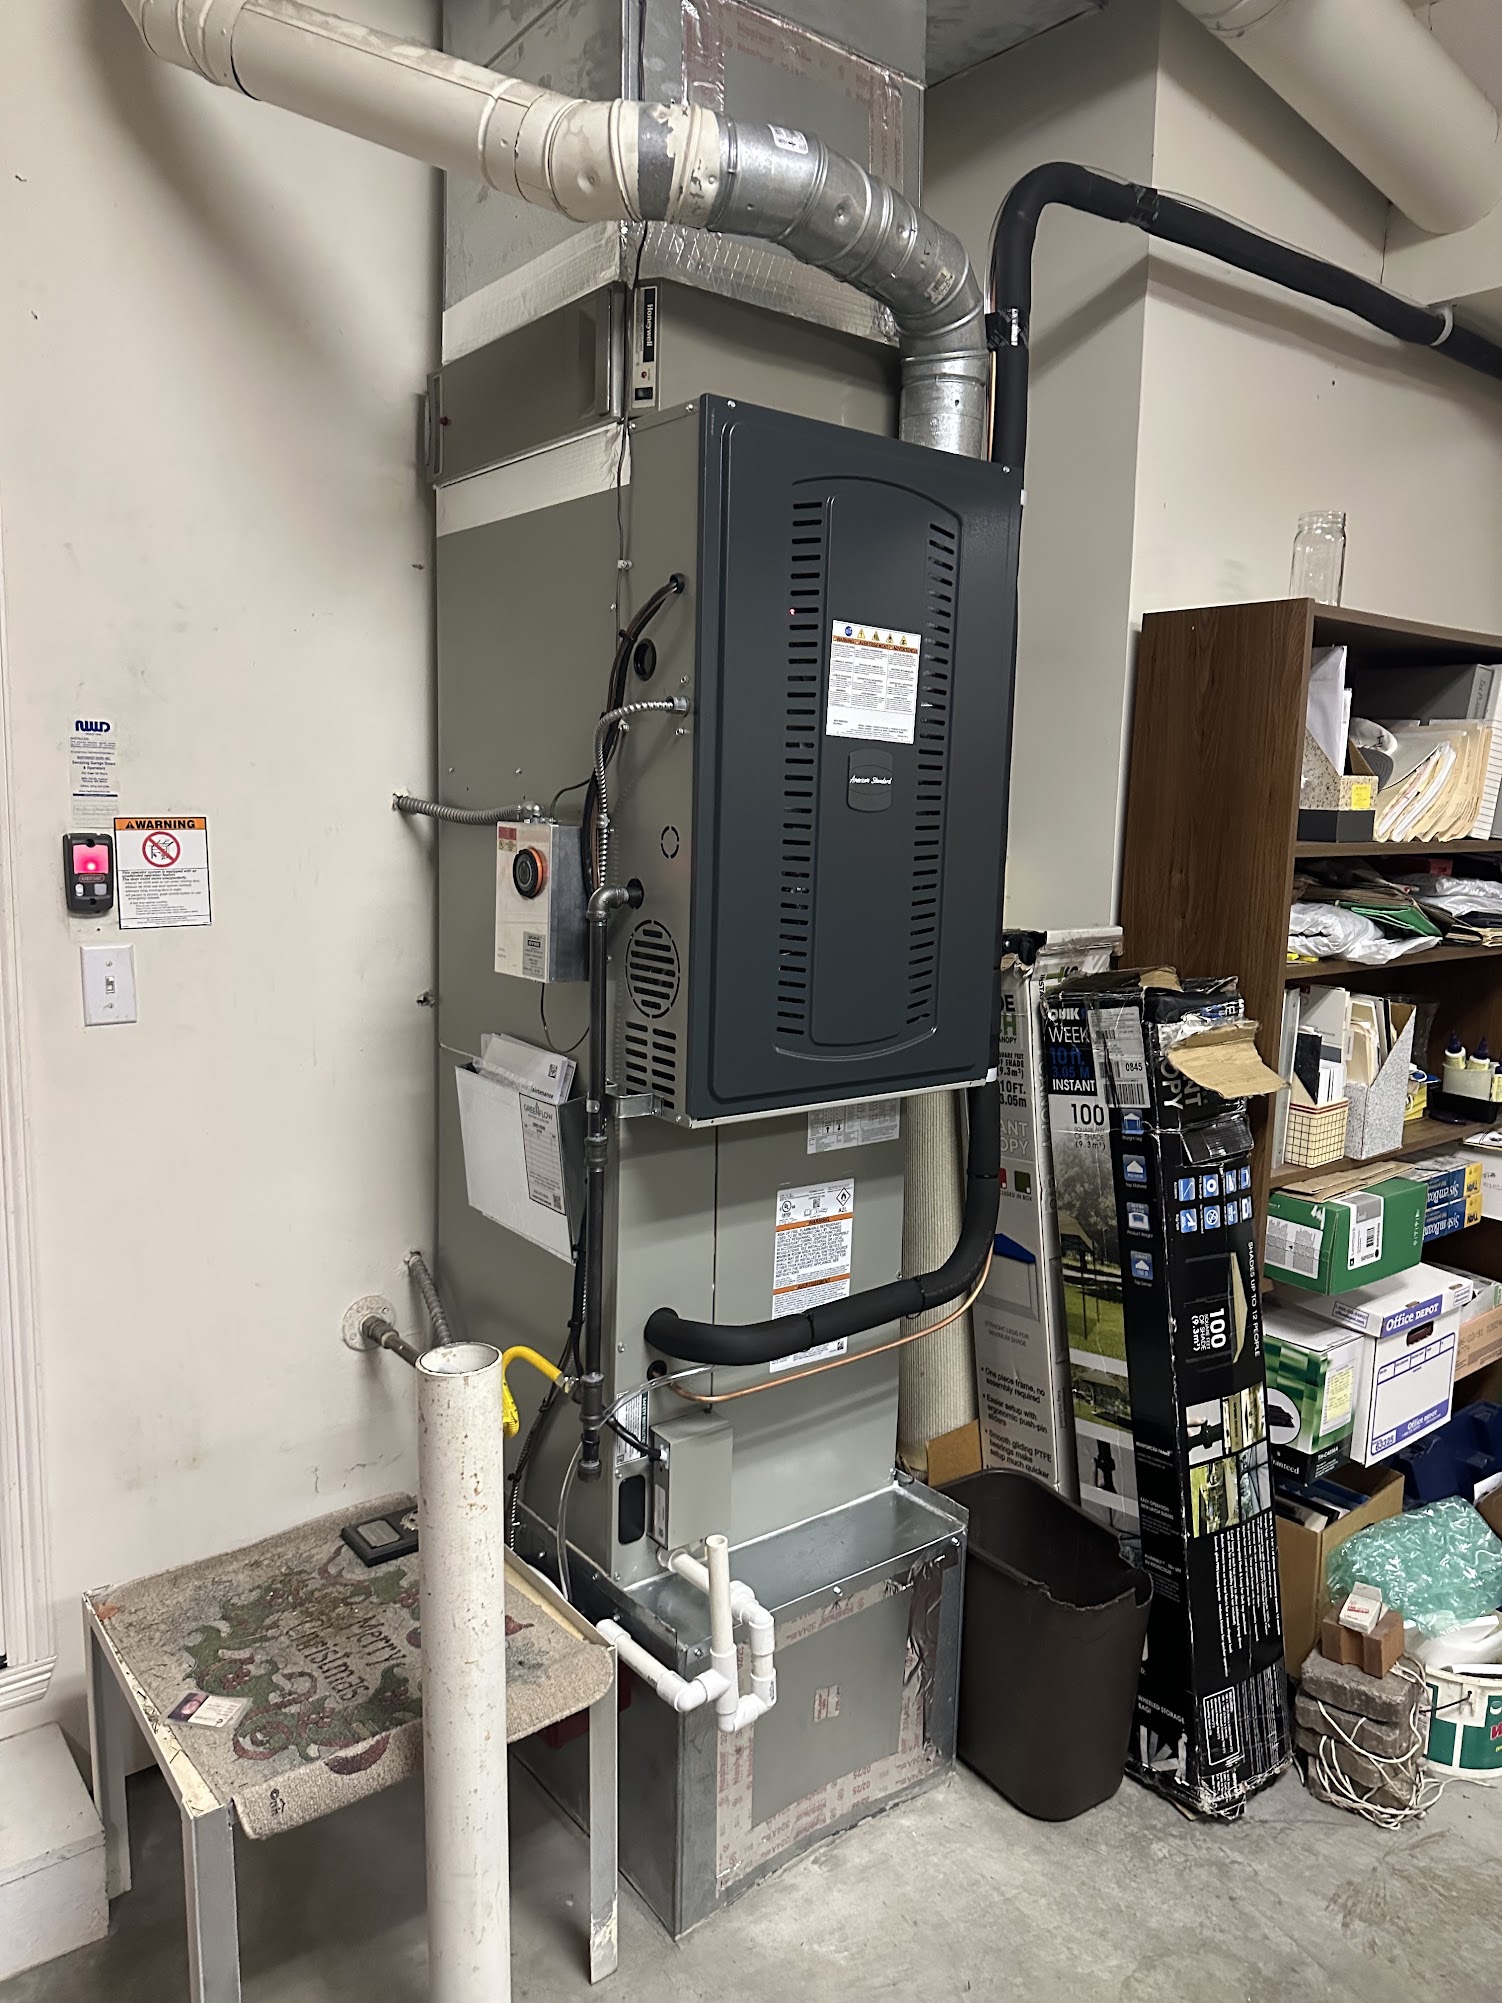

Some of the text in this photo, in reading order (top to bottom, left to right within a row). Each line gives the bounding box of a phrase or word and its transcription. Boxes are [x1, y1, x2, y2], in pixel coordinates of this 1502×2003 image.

[850, 775, 892, 784] American Standard
[136, 820, 196, 829] WARNING
[1048, 1026, 1090, 1043] WEEK
[1052, 1066, 1090, 1078] 3.05 M
[530, 1086, 554, 1099] aintenance
[1052, 1079, 1095, 1092] INSTANT
[1160, 1060, 1184, 1110] OPY
[1071, 1104, 1104, 1126] 100
[1000, 1138, 1029, 1156] OPY
[1250, 1280, 1256, 1292] UP
[1252, 1293, 1257, 1306] TO
[1252, 1310, 1258, 1320] 12
[1386, 1302, 1439, 1332] Office DEPOT
[1019, 1332, 1029, 1340] FOR
[1210, 1308, 1226, 1348] 100
[985, 1367, 1045, 1396] One piece frame, no
[986, 1377, 1040, 1404] assembly required
[1004, 1402, 1022, 1415] setup
[1024, 1409, 1037, 1421] with
[1407, 1410, 1438, 1430] Office DEPOT
[1019, 1418, 1048, 1435] push-pin
[1012, 1438, 1033, 1457] gliding
[1034, 1448, 1052, 1463] PTFE
[1015, 1450, 1033, 1464] make
[1006, 1456, 1024, 1469] much
[1026, 1464, 1050, 1480] quicker
[340, 1614, 407, 1667] Merry
[286, 1618, 370, 1700] Christmas
[853, 1765, 871, 1779] 02/25
[852, 1780, 870, 1795] 02/25
